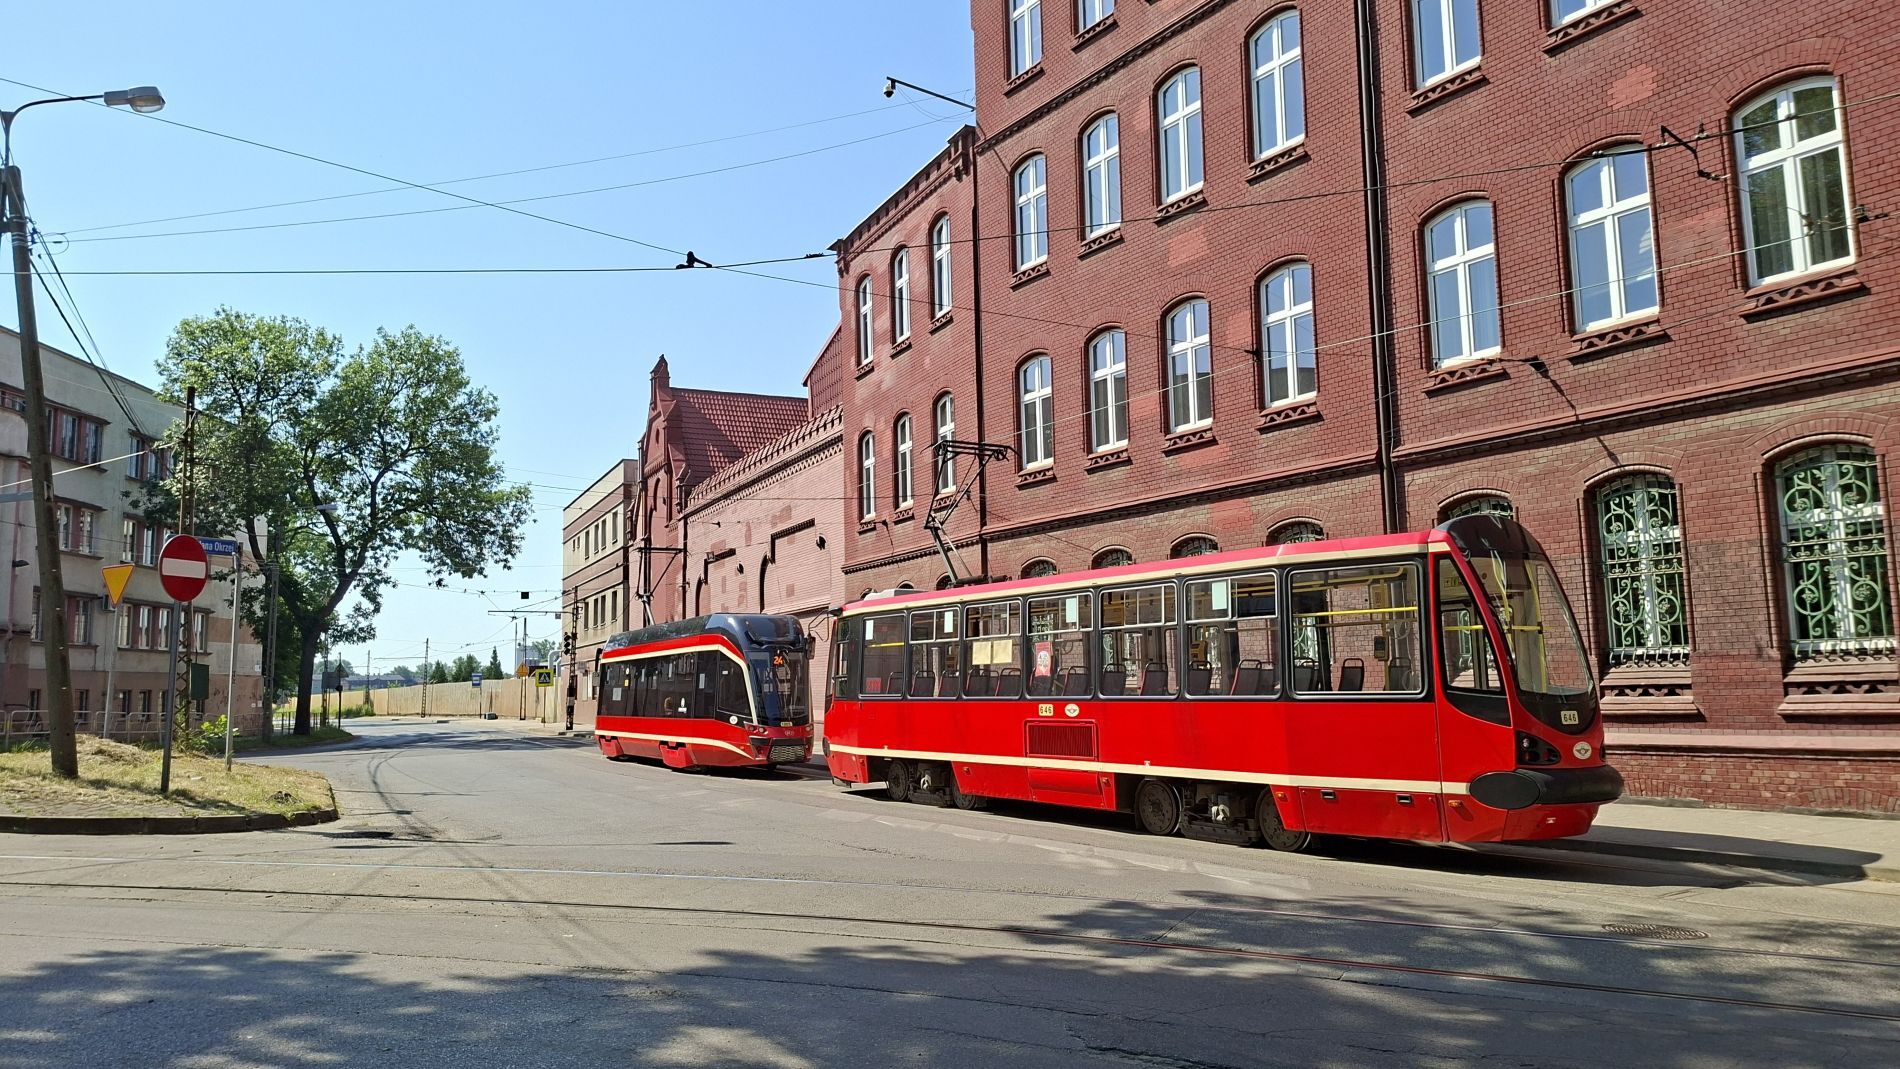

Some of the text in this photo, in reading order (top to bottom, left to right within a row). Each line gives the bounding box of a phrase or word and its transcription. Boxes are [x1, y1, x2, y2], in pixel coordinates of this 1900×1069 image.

[773, 655, 784, 665] 24
[1040, 705, 1052, 714] 646
[1563, 713, 1577, 722] 646
